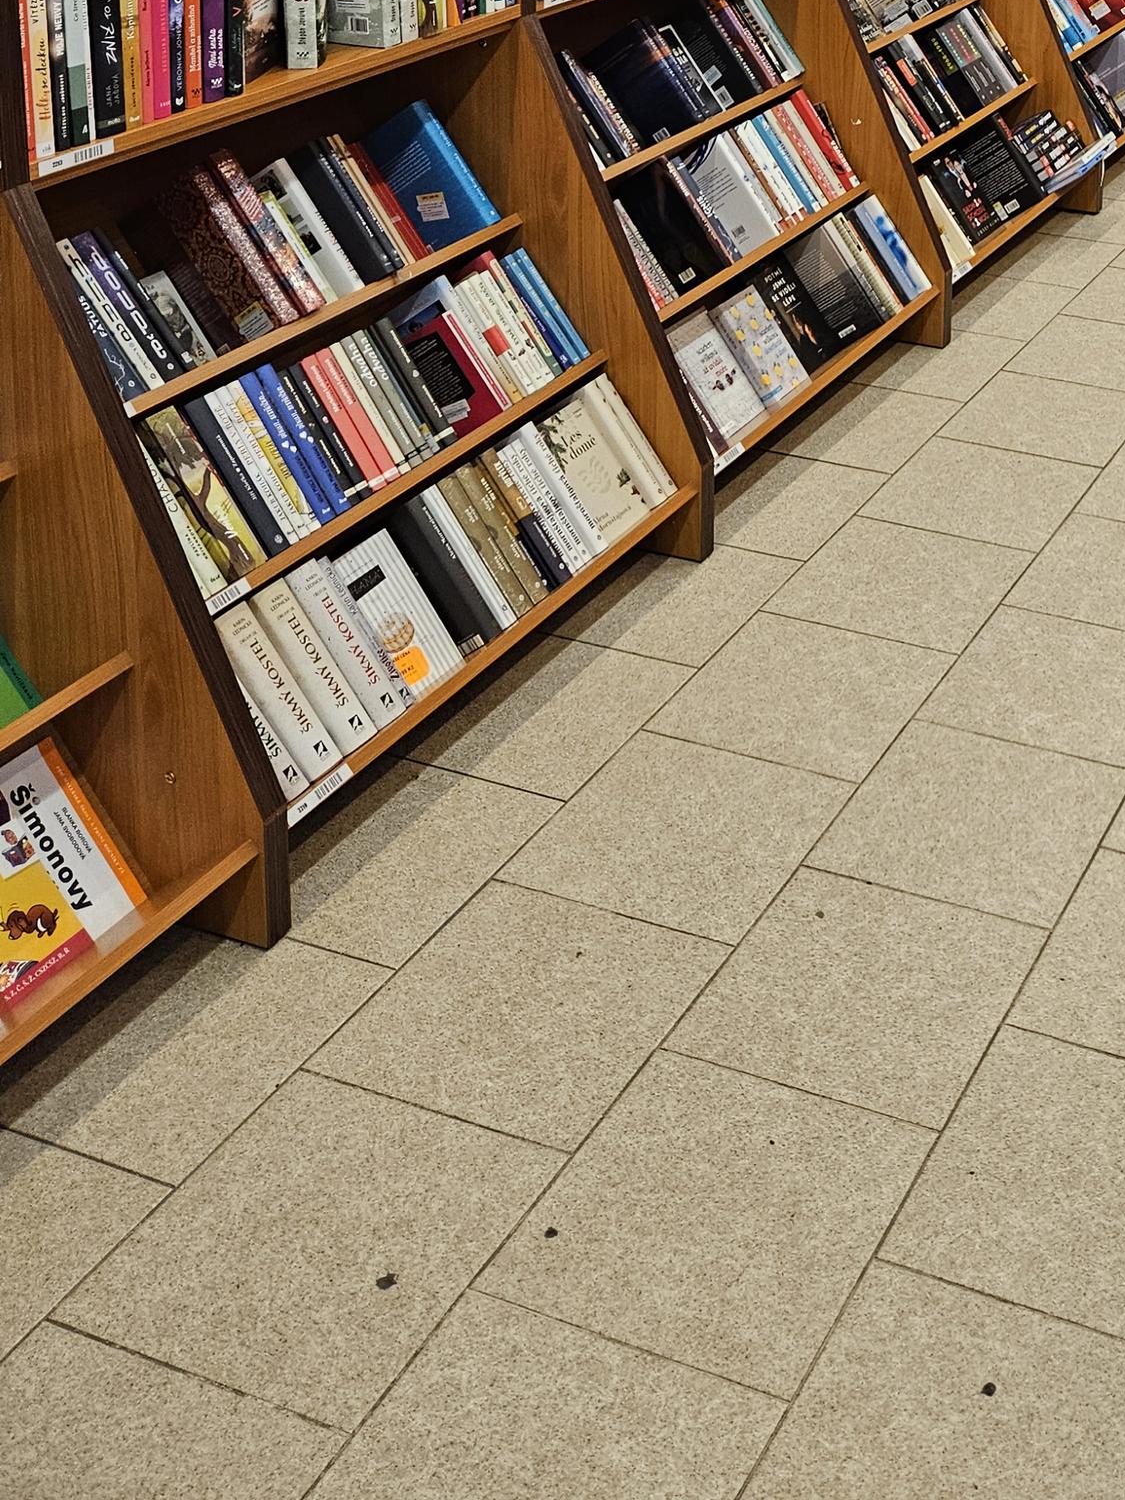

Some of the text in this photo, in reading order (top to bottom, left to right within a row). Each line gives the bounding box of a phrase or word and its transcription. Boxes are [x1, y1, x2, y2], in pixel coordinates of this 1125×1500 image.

[53, 2, 62, 30] NERVY
[102, 4, 111, 21] TO
[176, 55, 184, 93] VERONIKA
[287, 613, 349, 708] ŠIKMÝ KOSTEL
[321, 595, 380, 687] ŠIKMÝ KOSTEL
[250, 637, 313, 734] ŠIKMÝ KOSTEL
[10, 782, 92, 912] Šimonovy
[53, 811, 86, 860] JANA SVOBODOVÁ
